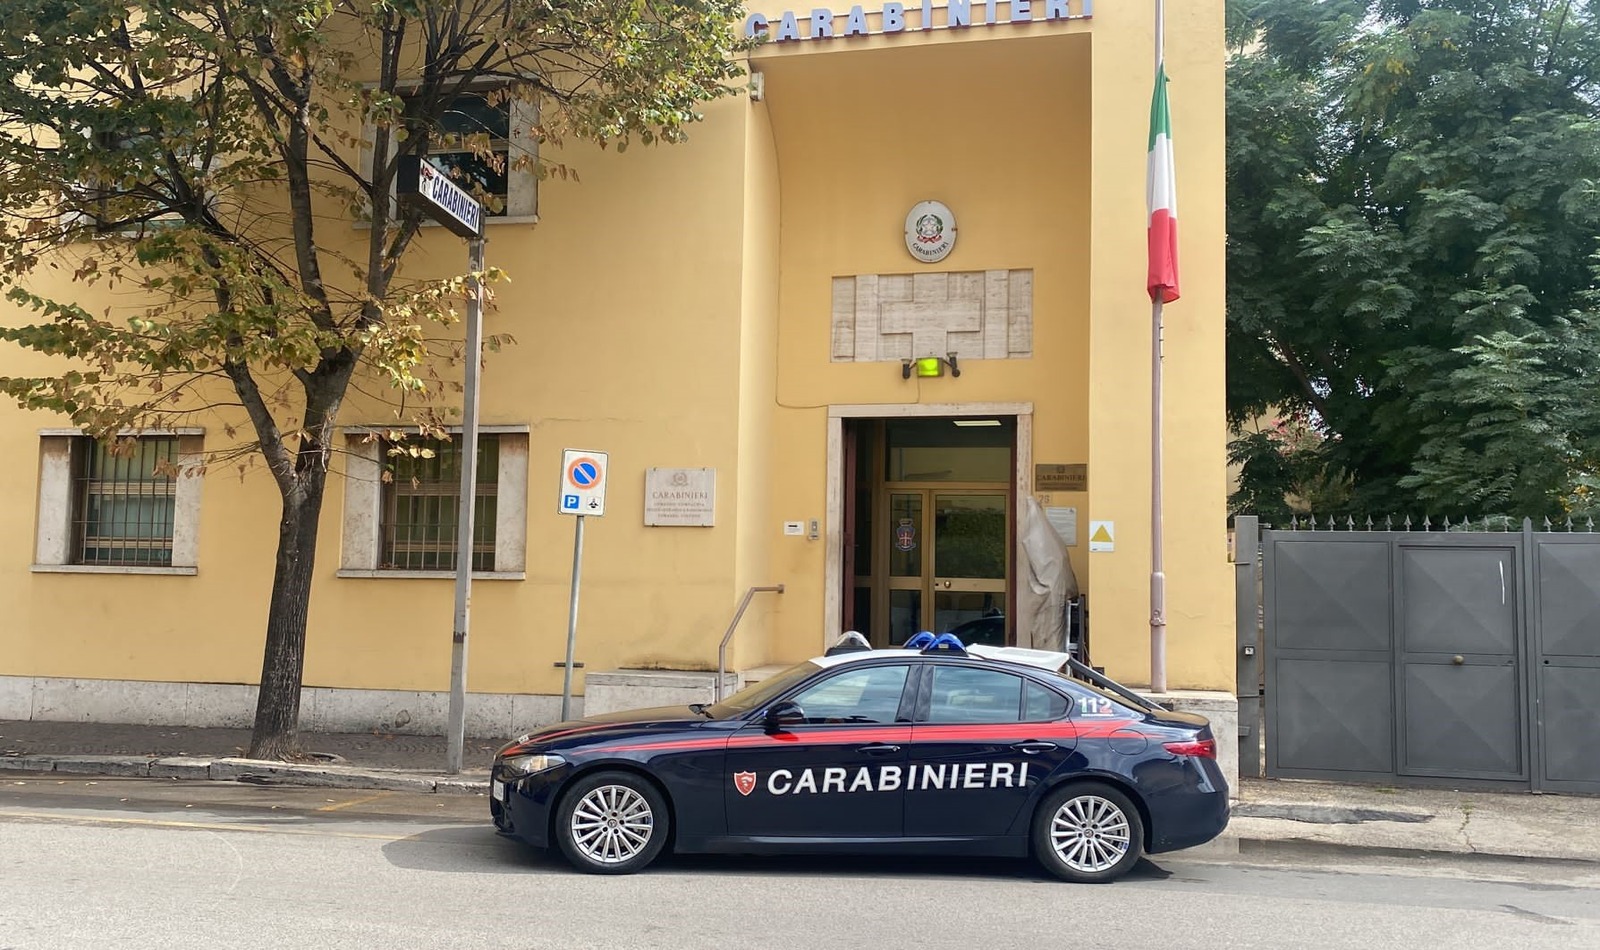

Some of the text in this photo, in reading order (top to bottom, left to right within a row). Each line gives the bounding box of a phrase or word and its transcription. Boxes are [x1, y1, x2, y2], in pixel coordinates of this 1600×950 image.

[744, 0, 1093, 41] CARABINIERI
[432, 175, 480, 229] CARABINIERI
[912, 241, 949, 255] CARABINIERI
[567, 496, 577, 507] P
[652, 491, 708, 499] CARABINIERI
[1078, 697, 1113, 713] 112
[767, 762, 1029, 795] CARABINIERI
